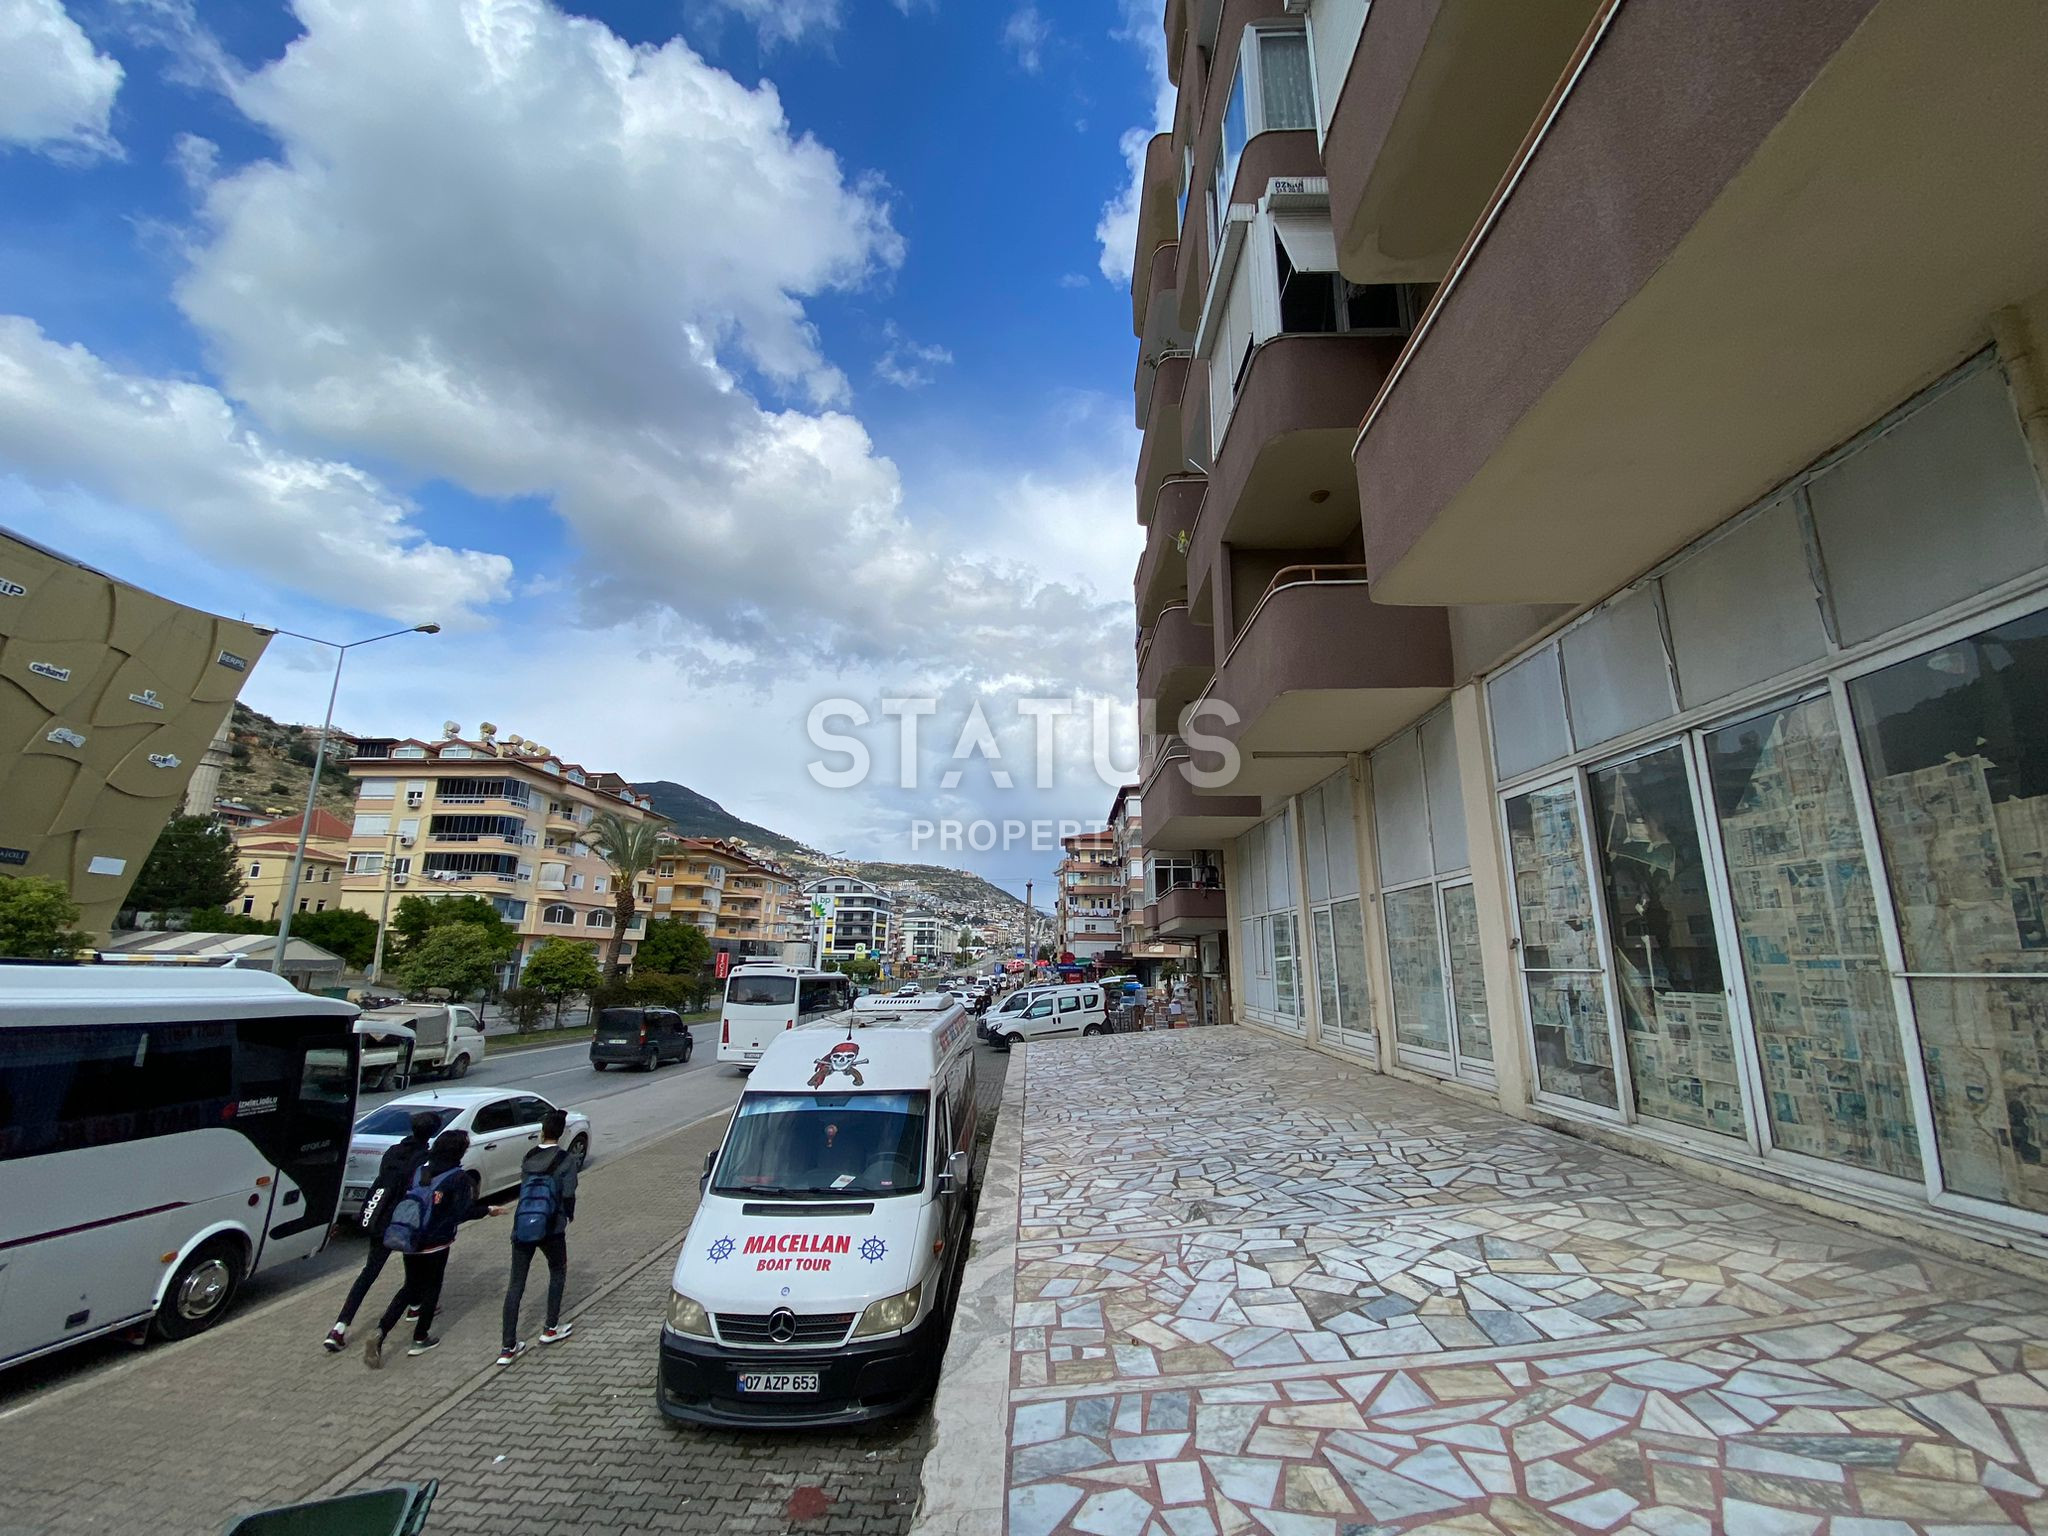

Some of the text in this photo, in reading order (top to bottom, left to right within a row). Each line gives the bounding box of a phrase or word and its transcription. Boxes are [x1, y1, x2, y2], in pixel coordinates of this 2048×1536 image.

[820, 896, 831, 905] bp
[362, 1188, 385, 1227] adidas
[743, 1235, 851, 1254] MACELLAN
[756, 1259, 832, 1271] BOAT TOUR
[745, 1376, 817, 1390] 07 AZP 653
